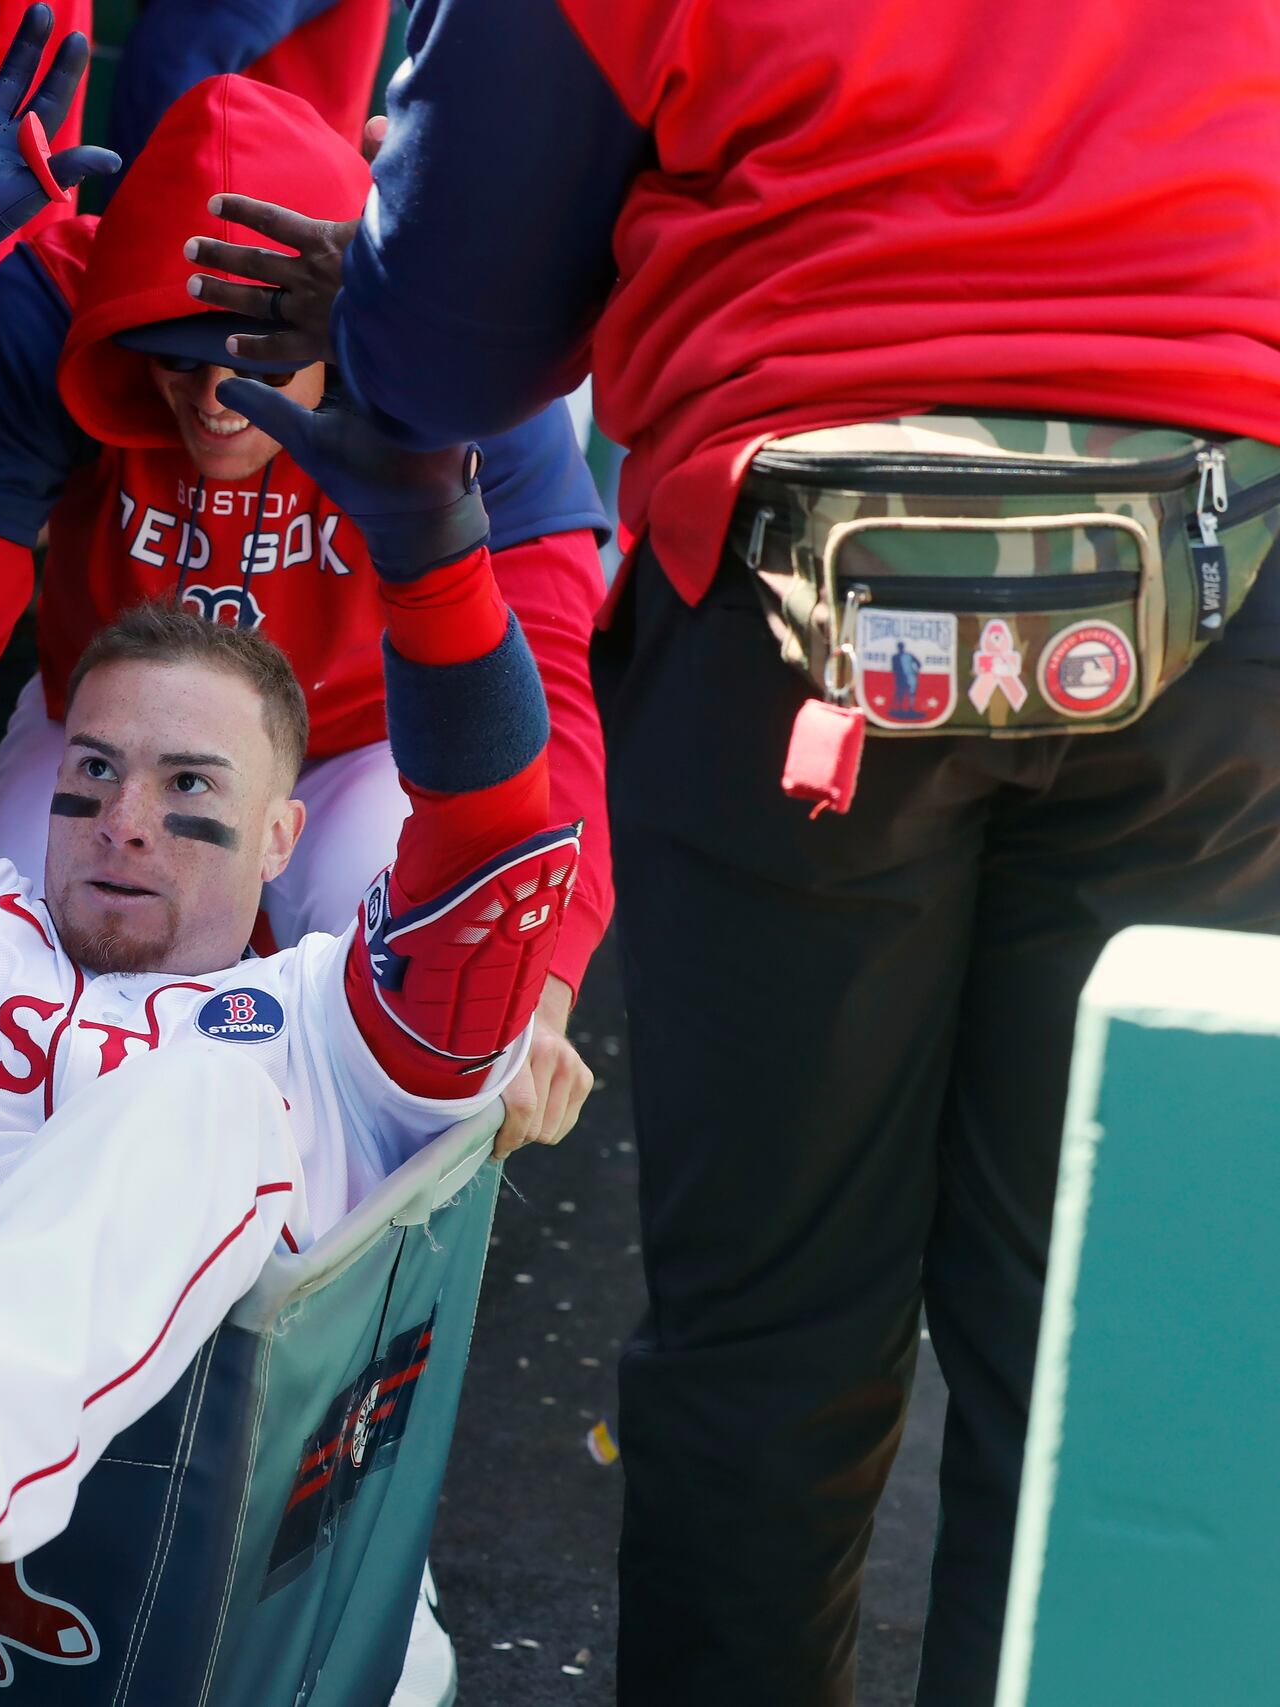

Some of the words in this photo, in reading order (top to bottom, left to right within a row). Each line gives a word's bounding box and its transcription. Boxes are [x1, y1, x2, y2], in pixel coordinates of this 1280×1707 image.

[1201, 561, 1221, 611] WATER
[222, 993, 257, 1024] B
[208, 1023, 276, 1034] STRONG
